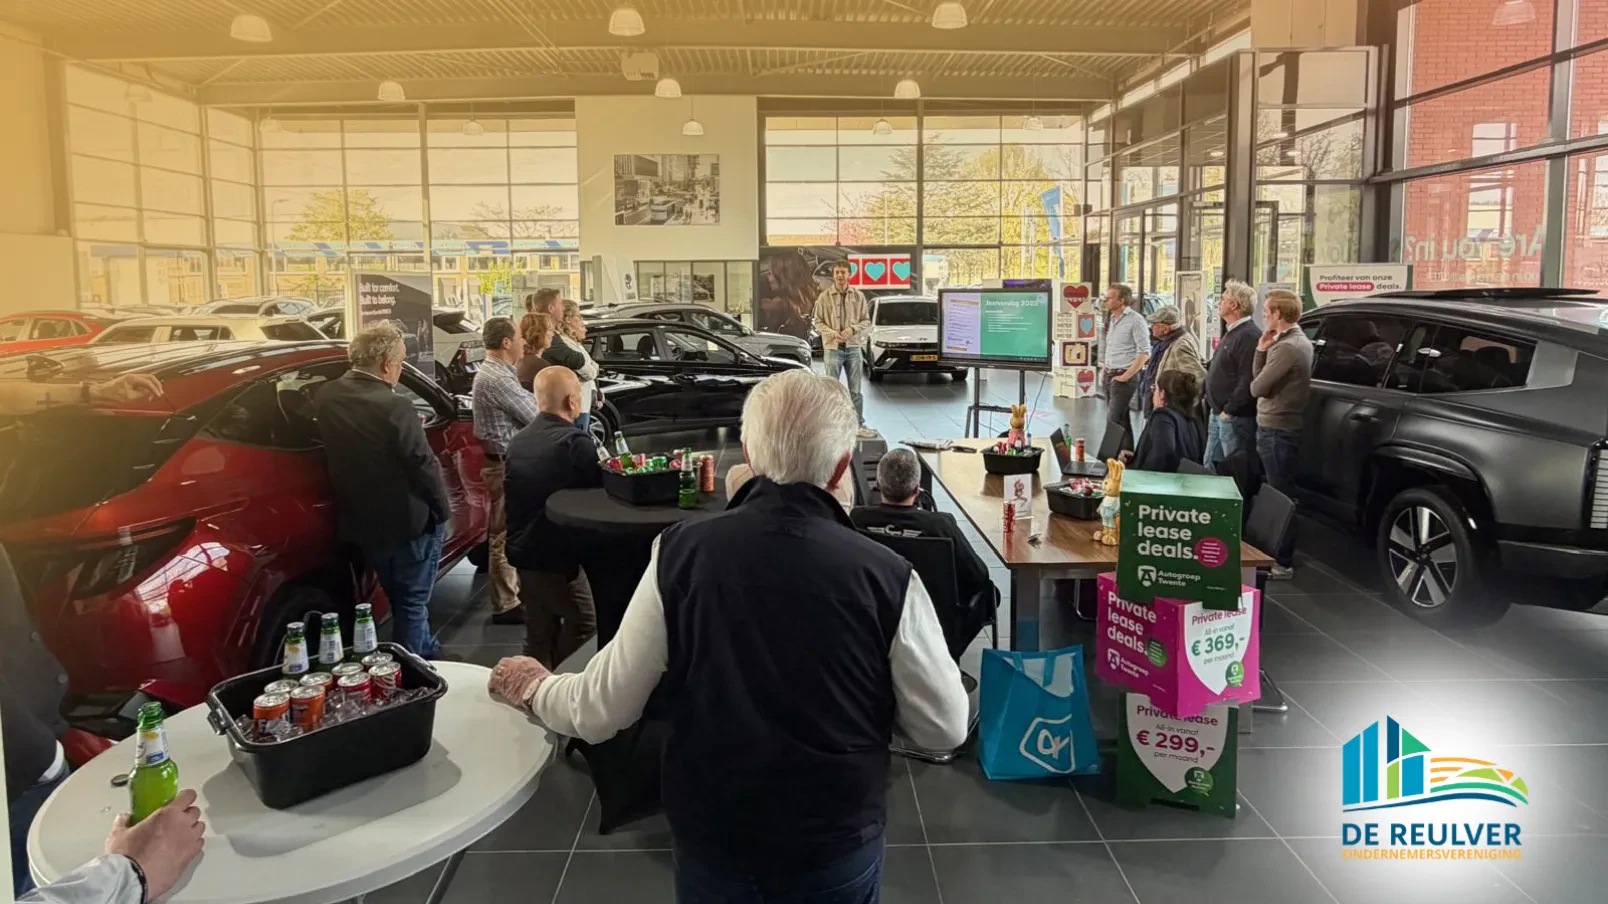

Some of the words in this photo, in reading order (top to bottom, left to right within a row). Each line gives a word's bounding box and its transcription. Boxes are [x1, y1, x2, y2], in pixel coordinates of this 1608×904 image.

[1320, 282, 1348, 290] Private
[1138, 505, 1212, 524] Private
[1138, 522, 1192, 540] lease
[1137, 540, 1199, 560] deals.
[1158, 570, 1201, 581] Autogroep
[1158, 577, 1186, 586] Twente
[1108, 590, 1157, 623] Private
[1192, 611, 1223, 626] Private
[1224, 606, 1247, 618] lease
[1108, 607, 1144, 635] lease
[1107, 625, 1149, 656] deals.
[1191, 640, 1201, 657] €
[1204, 632, 1245, 654] 369,-
[1136, 730, 1150, 746] €
[1155, 732, 1215, 758] 299,-
[1169, 754, 1199, 763] maand
